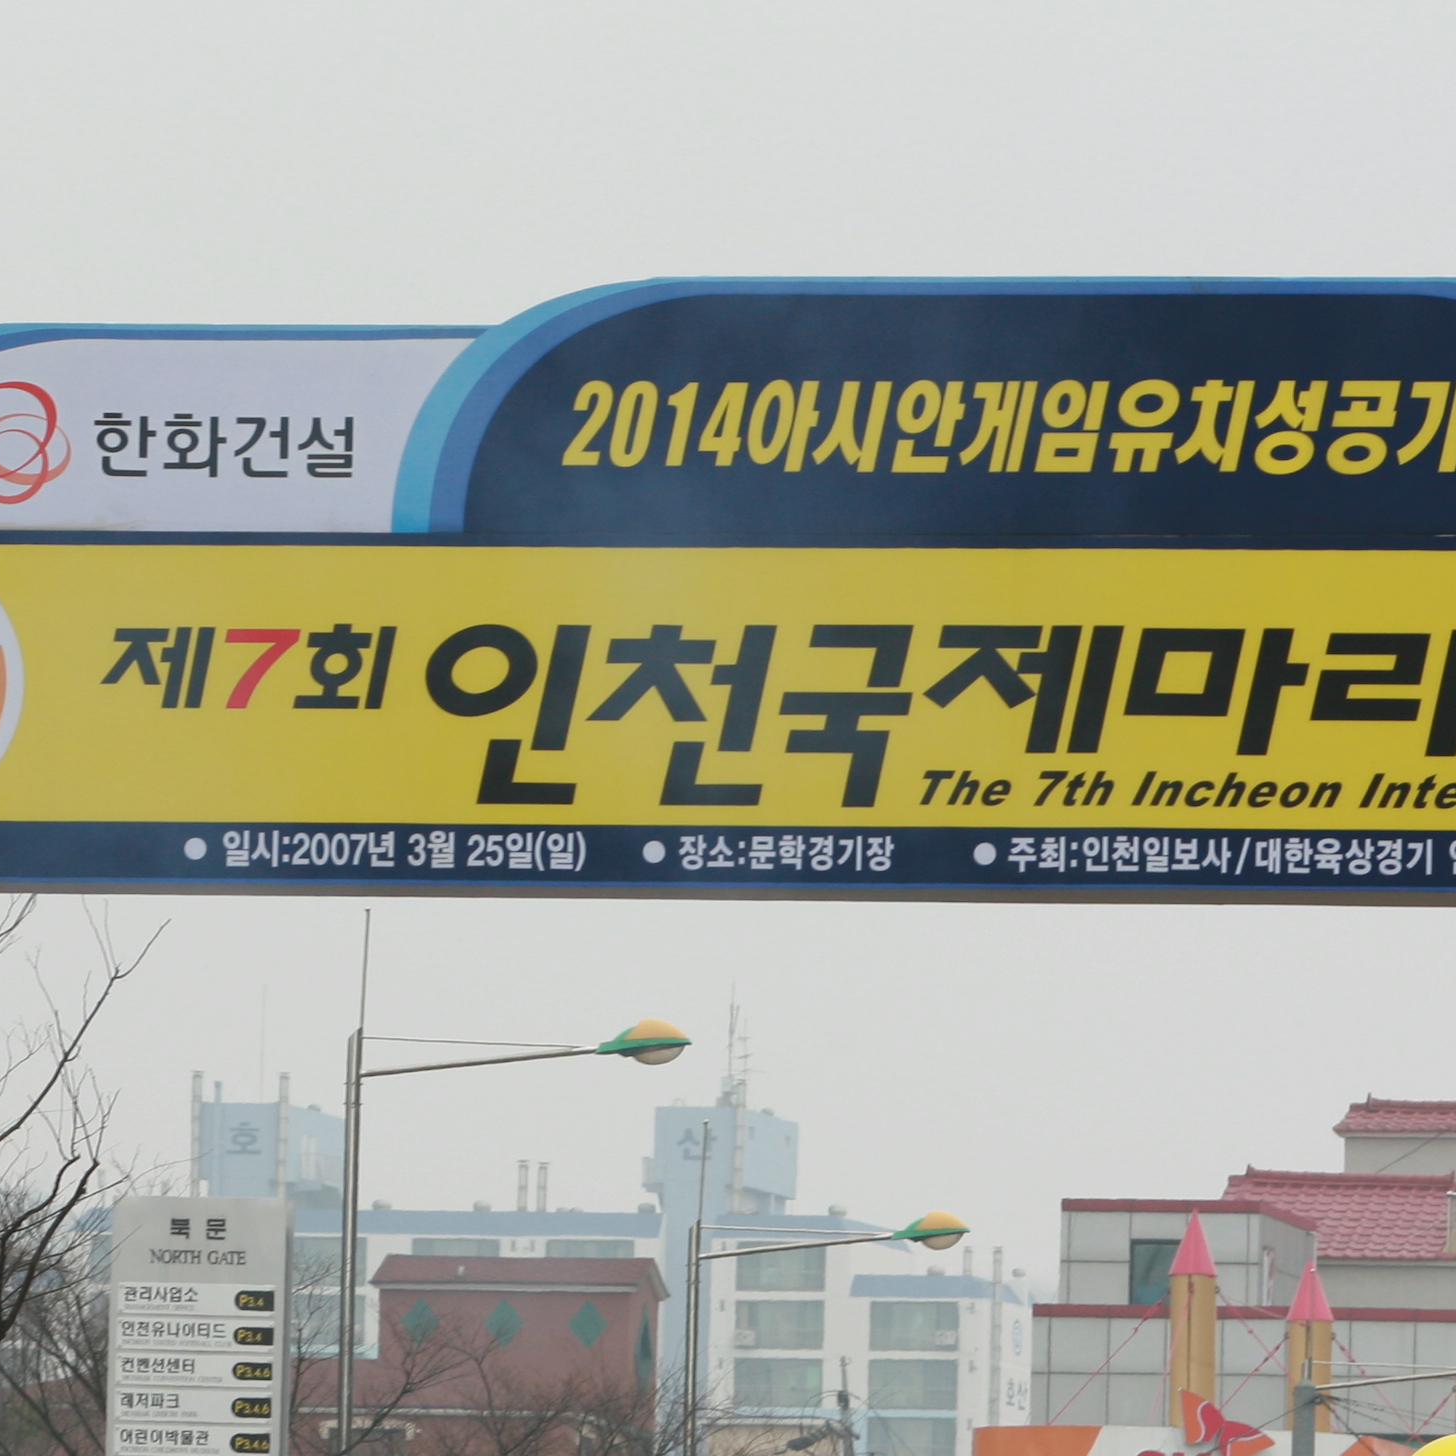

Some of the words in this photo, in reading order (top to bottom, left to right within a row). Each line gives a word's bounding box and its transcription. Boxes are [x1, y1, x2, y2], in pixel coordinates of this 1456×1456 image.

[95, 412, 355, 478] 한화건설
[102, 623, 397, 711] 제7회
[922, 770, 1011, 806] The
[1034, 770, 1114, 806] 7th
[1132, 771, 1342, 808] Incheon
[407, 830, 455, 868] 3월
[467, 831, 587, 870] 25일(일)
[678, 834, 894, 872] 장소:문학경기장
[150, 1249, 202, 1265] NORTH
[207, 1250, 247, 1266] GATE
